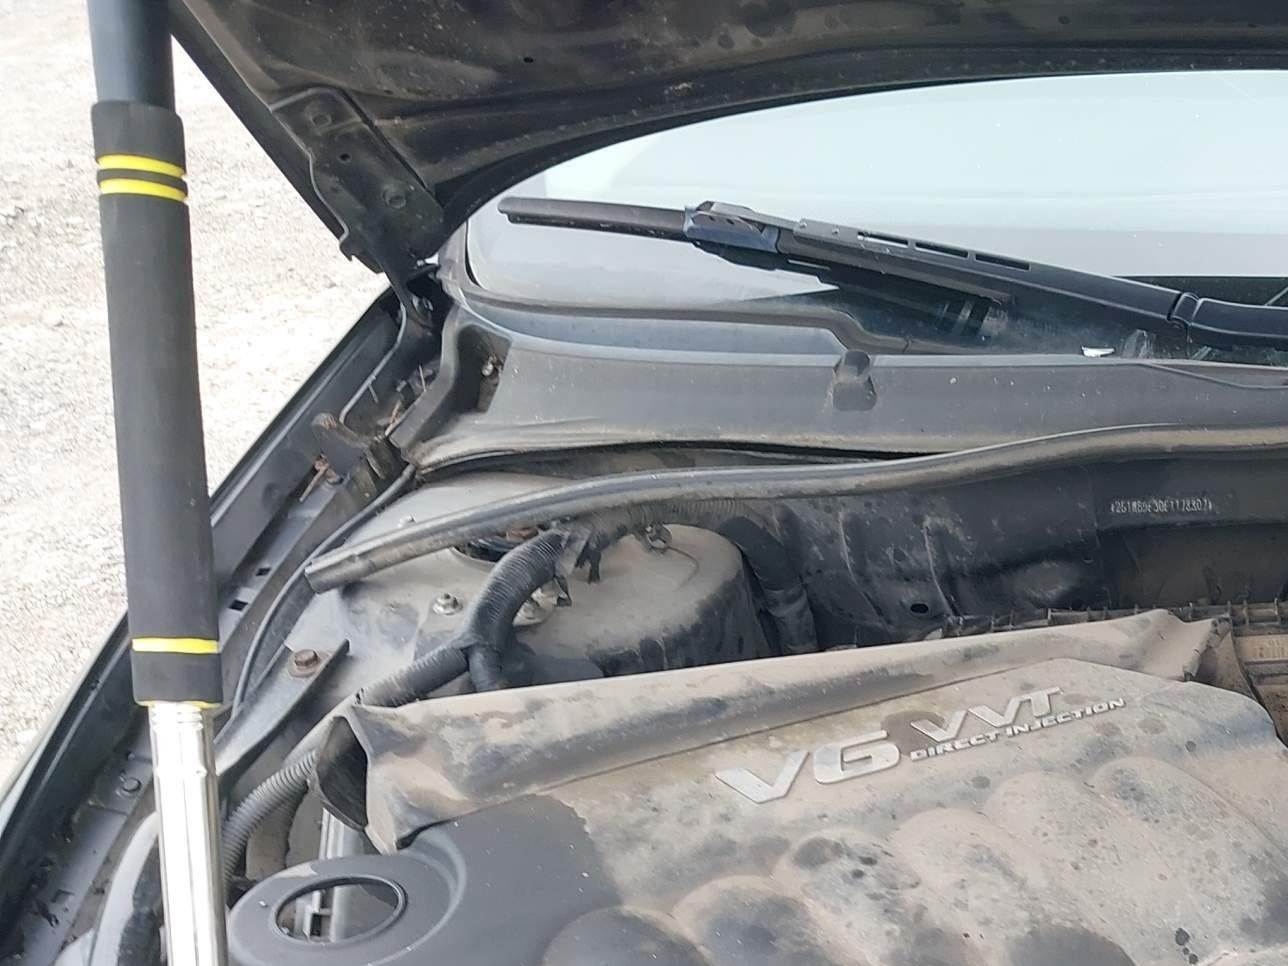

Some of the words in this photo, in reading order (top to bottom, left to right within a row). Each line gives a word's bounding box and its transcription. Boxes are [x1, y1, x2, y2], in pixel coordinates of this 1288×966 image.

[715, 729, 901, 804] V6
[910, 686, 1065, 743] VVT
[910, 729, 1005, 762] DIRECT
[1005, 697, 1126, 738] INJECTION
